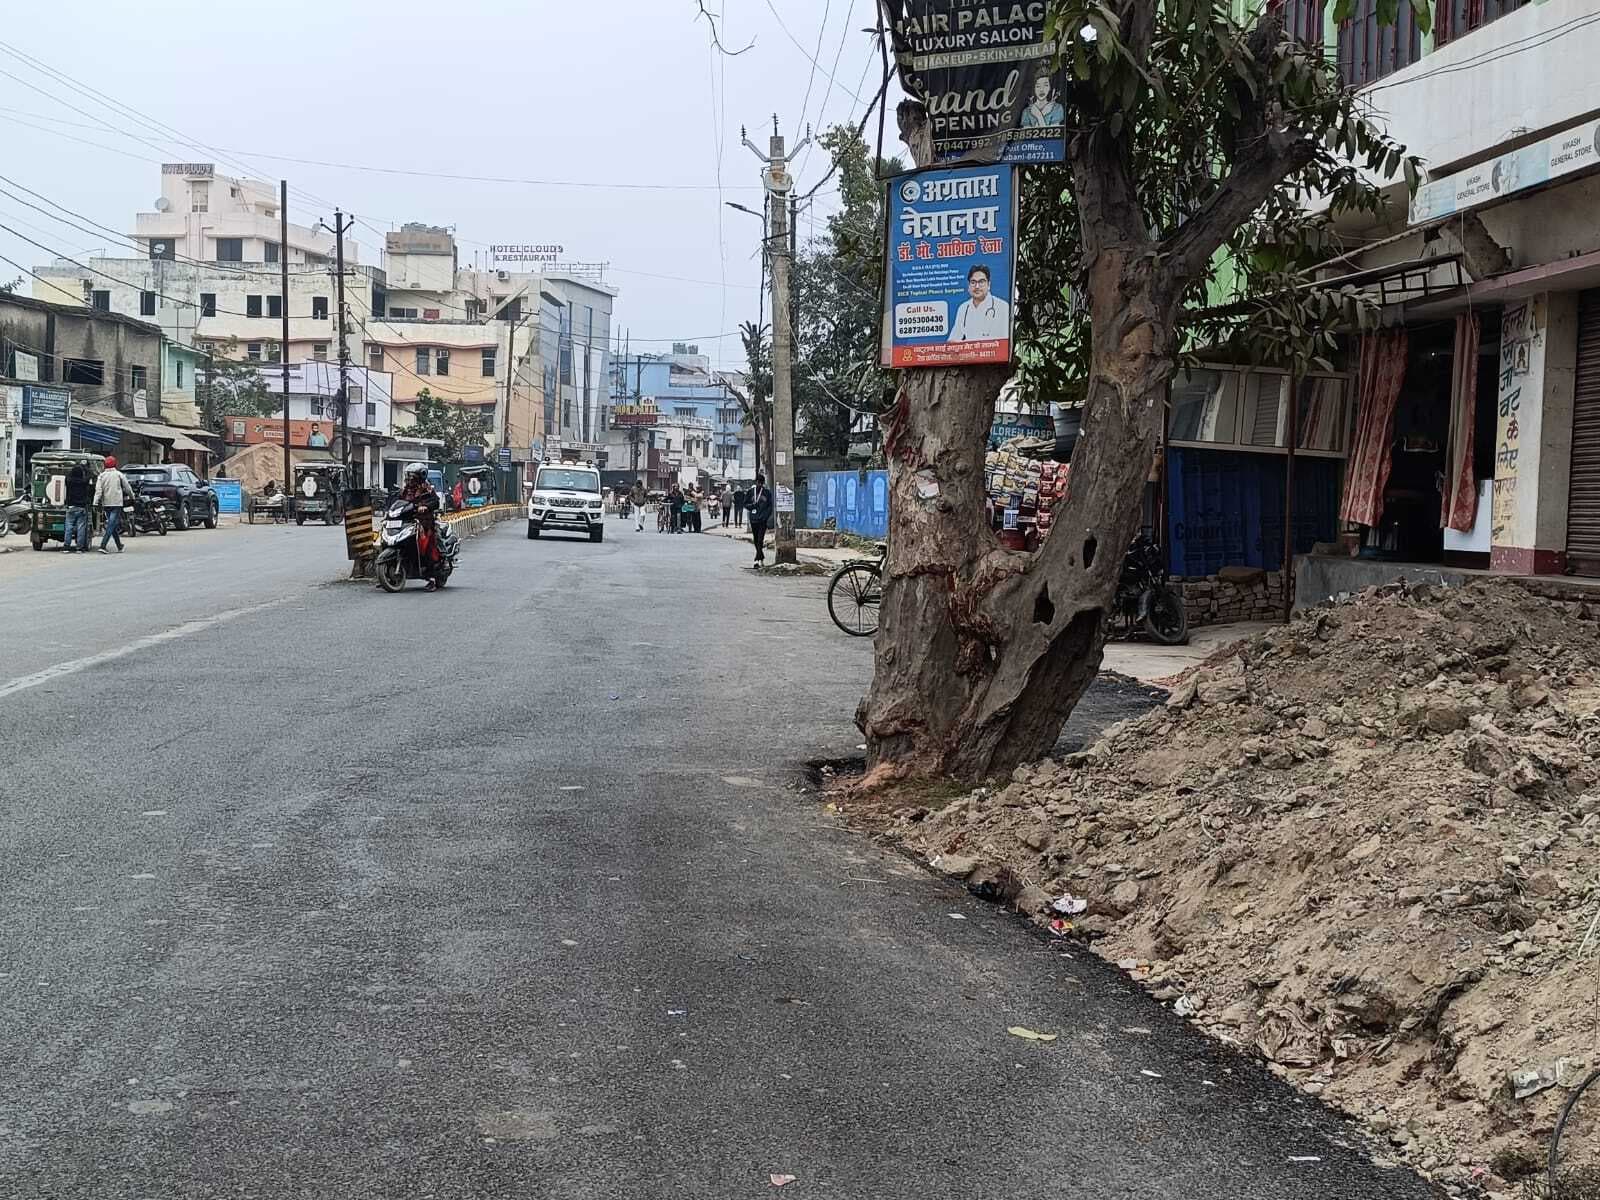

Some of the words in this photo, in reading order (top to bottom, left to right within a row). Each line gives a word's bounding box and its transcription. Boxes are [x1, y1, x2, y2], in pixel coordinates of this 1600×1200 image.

[916, 33, 976, 52] LUXURY
[980, 27, 1033, 45] SALON
[980, 49, 1008, 62] SKIN
[1015, 46, 1040, 58] NAIL
[1562, 136, 1581, 151] VIKASH
[1550, 153, 1573, 167] GENERAL
[1574, 145, 1592, 160] STORE
[922, 174, 999, 202] अग्रतारा
[900, 206, 999, 239] नेत्रालय
[490, 245, 522, 253] HOTEL
[907, 305, 921, 314] Call
